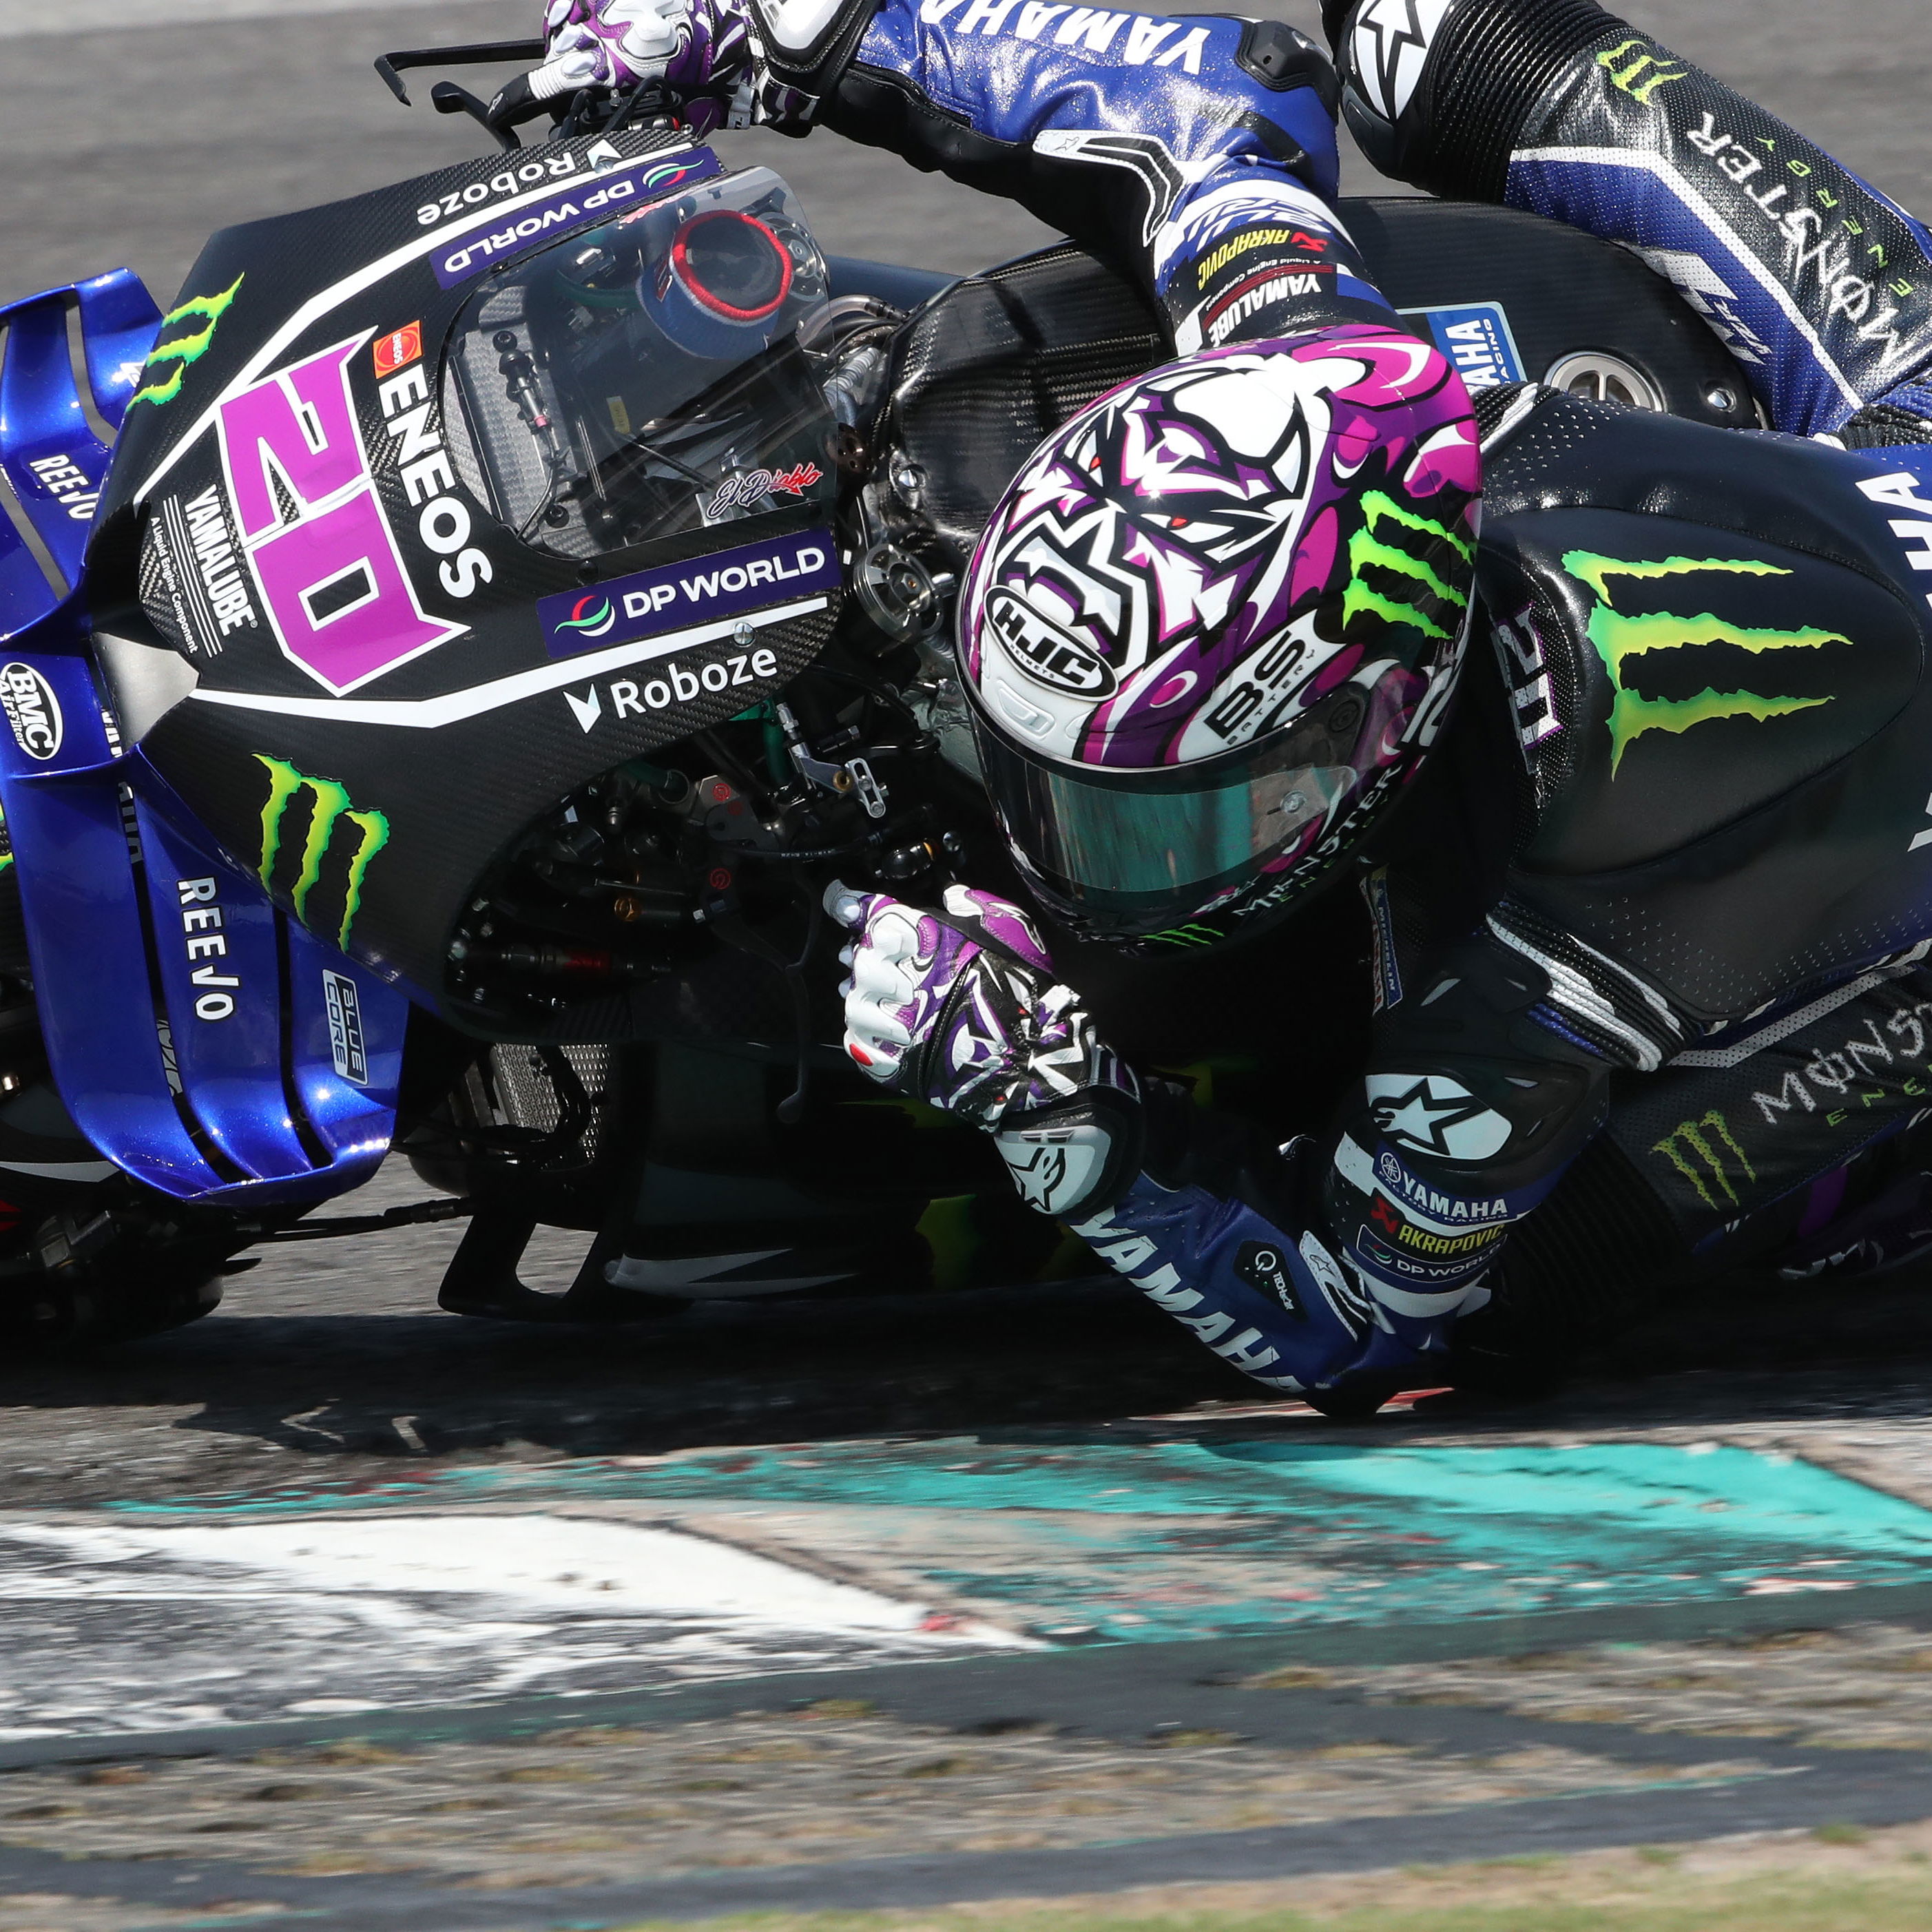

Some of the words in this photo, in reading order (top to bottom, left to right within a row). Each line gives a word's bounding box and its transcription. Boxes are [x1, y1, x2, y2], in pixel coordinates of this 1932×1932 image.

[417, 152, 576, 225] Roboze
[583, 180, 635, 209] DP
[1755, 136, 1914, 298] ENERGY
[444, 209, 579, 273] WORLD
[1209, 274, 1322, 347] YAMALUBE
[392, 333, 404, 364] ENEOS
[1445, 320, 1502, 386] AHA
[1483, 318, 1510, 385] ACING
[216, 326, 471, 698] 20
[378, 363, 494, 598] ENEOS
[151, 517, 160, 526] A
[153, 524, 168, 557] Liquid
[160, 557, 176, 592] Engine
[623, 585, 676, 619] DP
[679, 547, 826, 603] WORLD
[172, 592, 198, 654] Component
[994, 600, 1099, 685] HJC
[610, 647, 778, 719] Roboze
[1010, 643, 1055, 679] HELMETS
[1203, 630, 1306, 739] BS
[8, 671, 54, 750] BMC
[178, 877, 239, 1021] REEVO
[326, 981, 346, 1066] CORE
[342, 988, 362, 1072] BLUE
[1403, 1170, 1508, 1218] YAMAHA
[1397, 1258, 1425, 1274] DP
[1429, 1243, 1502, 1277] WORLD
